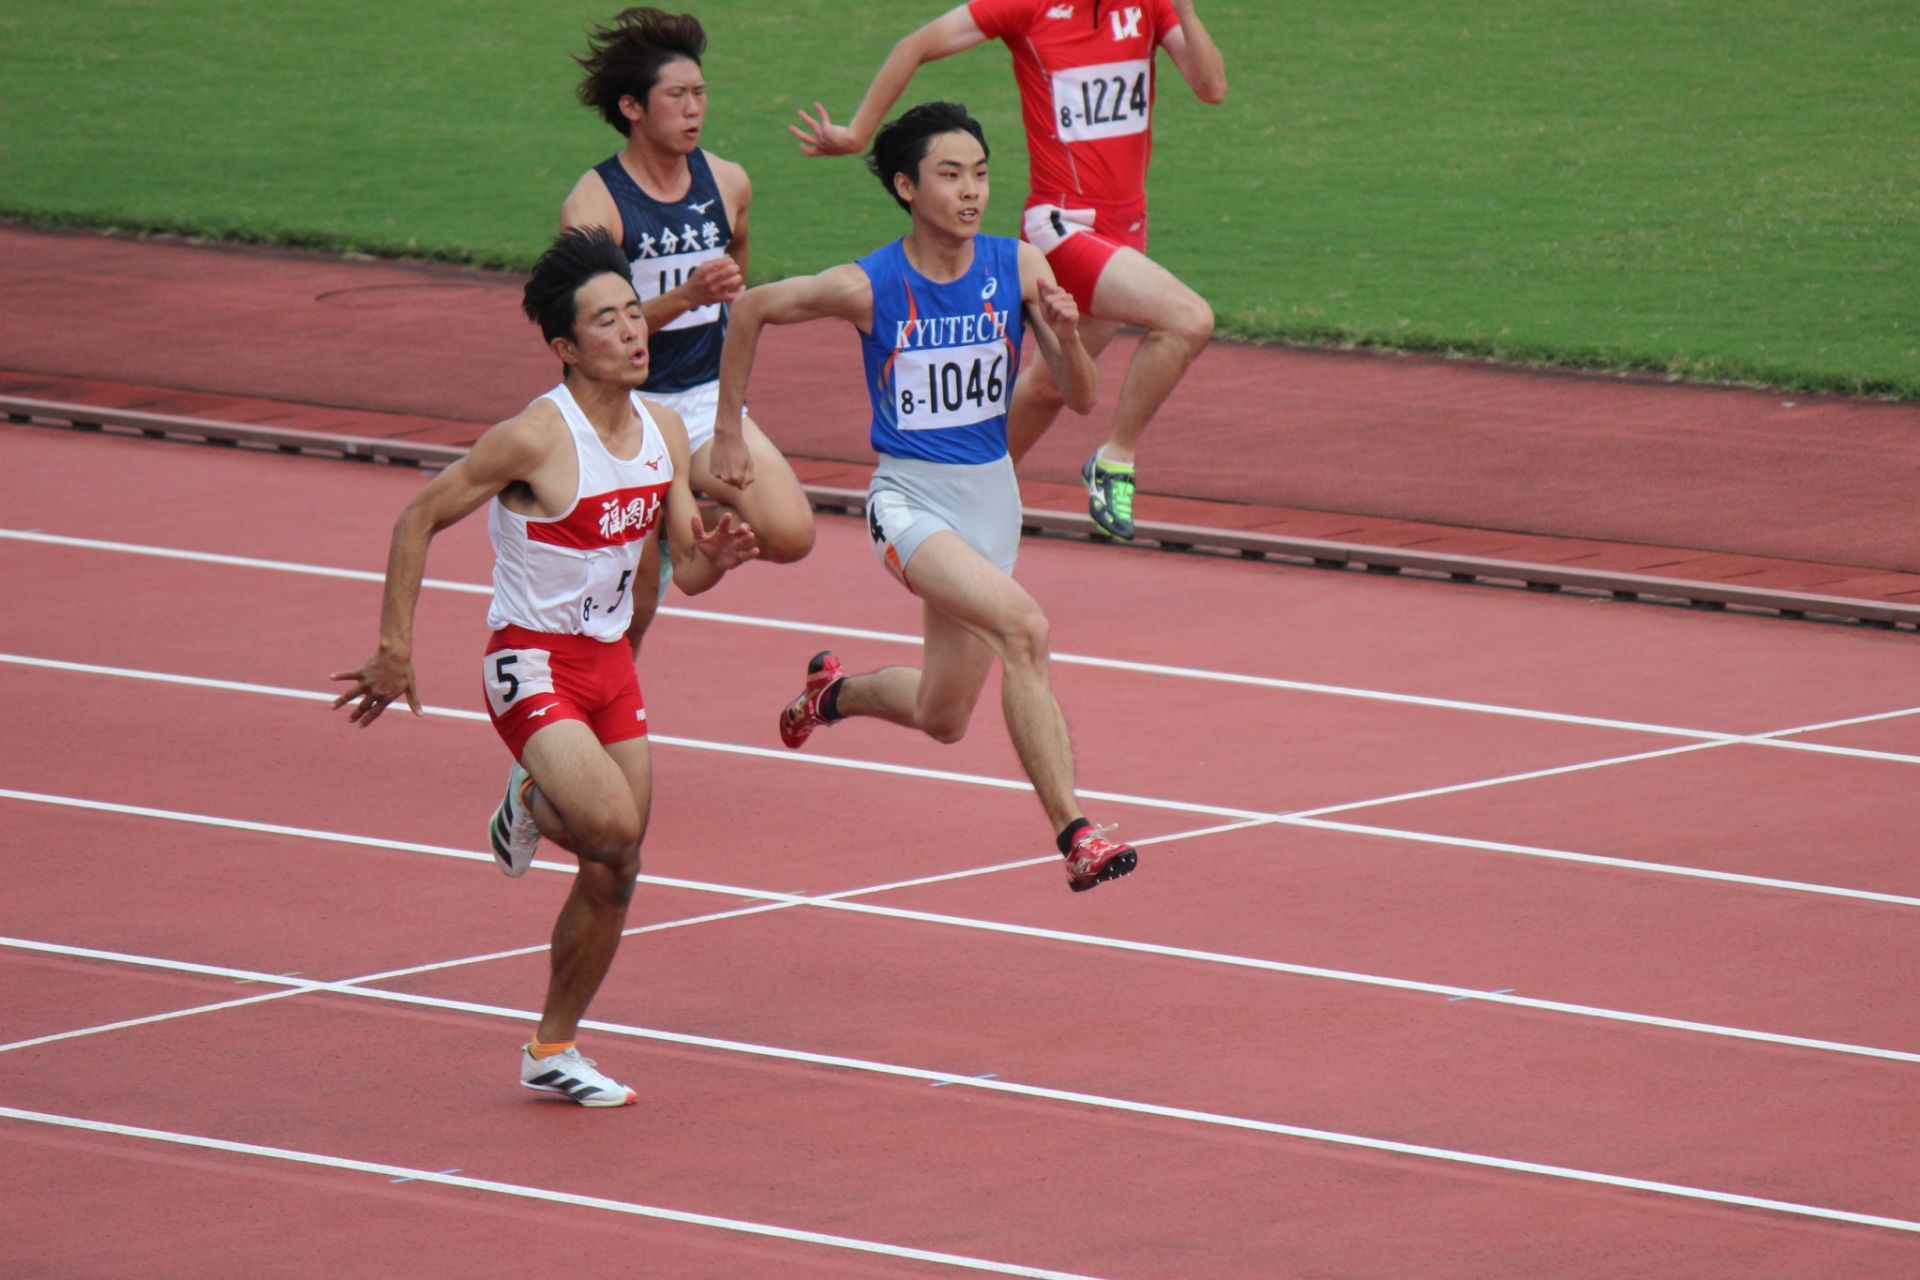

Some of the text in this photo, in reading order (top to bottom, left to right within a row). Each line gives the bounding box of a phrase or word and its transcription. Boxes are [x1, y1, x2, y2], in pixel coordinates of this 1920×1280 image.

[1060, 71, 1147, 128] 8-1224
[638, 221, 720, 259] 大分大学
[895, 310, 1009, 349] KYUTECH
[901, 354, 1003, 415] 8-1046
[869, 501, 887, 543] 4
[496, 655, 518, 702] 5
